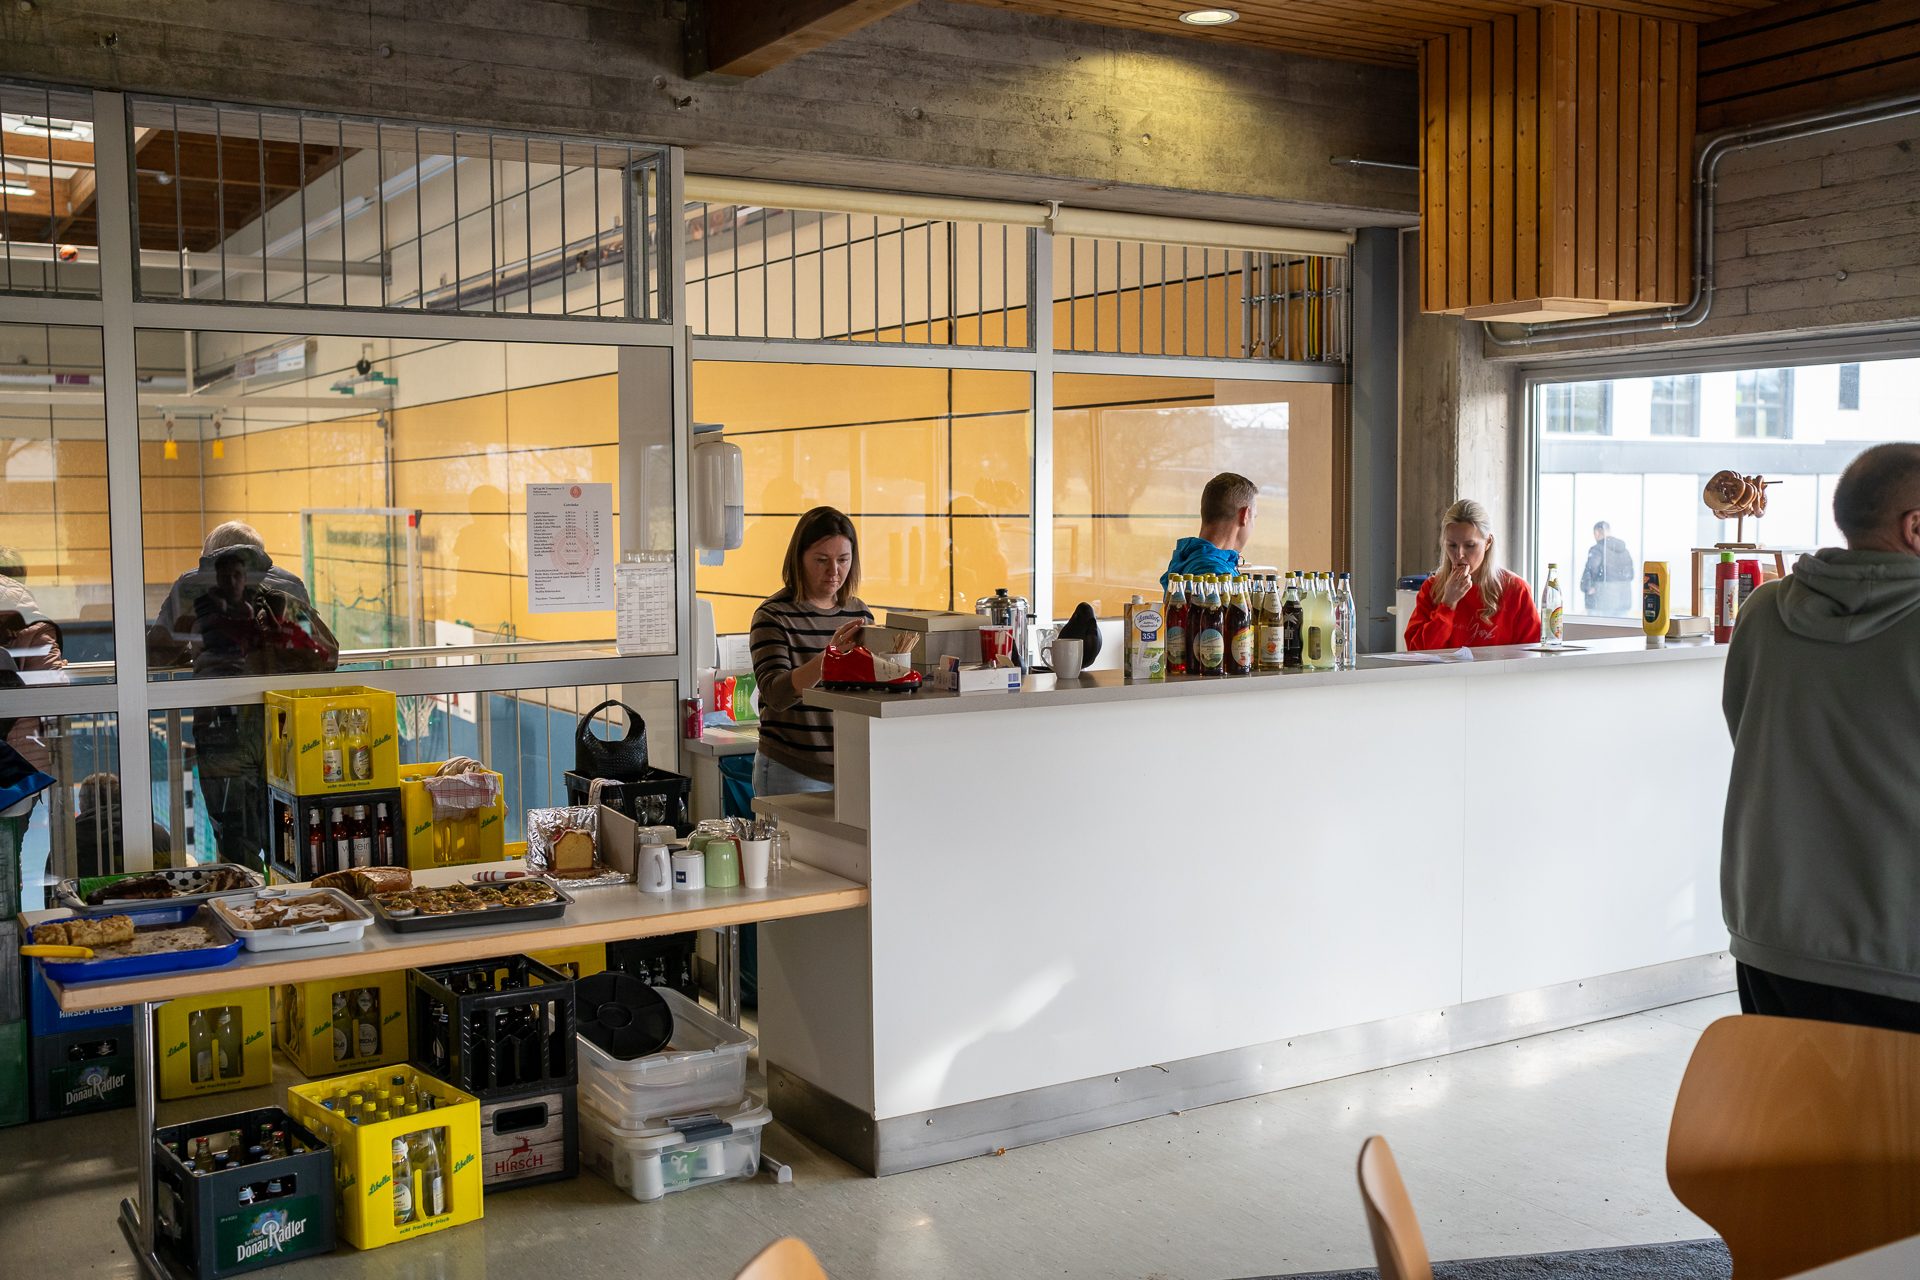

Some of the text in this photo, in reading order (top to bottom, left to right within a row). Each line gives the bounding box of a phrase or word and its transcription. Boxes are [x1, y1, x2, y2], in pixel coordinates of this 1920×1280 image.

[301, 739, 320, 754] Libella
[373, 734, 391, 748] Libella
[413, 821, 431, 836] Libella
[481, 815, 498, 829] Libella
[384, 1011, 401, 1025] Libella
[312, 1021, 331, 1037] Libella
[245, 1030, 264, 1045] Libella
[167, 1041, 188, 1057] Libella
[66, 1073, 125, 1106] Donau Radler
[453, 1153, 475, 1174] Libella
[495, 1153, 543, 1174] HIRSCH
[368, 1175, 391, 1196] Libella
[236, 1218, 307, 1263] Donau Radler
